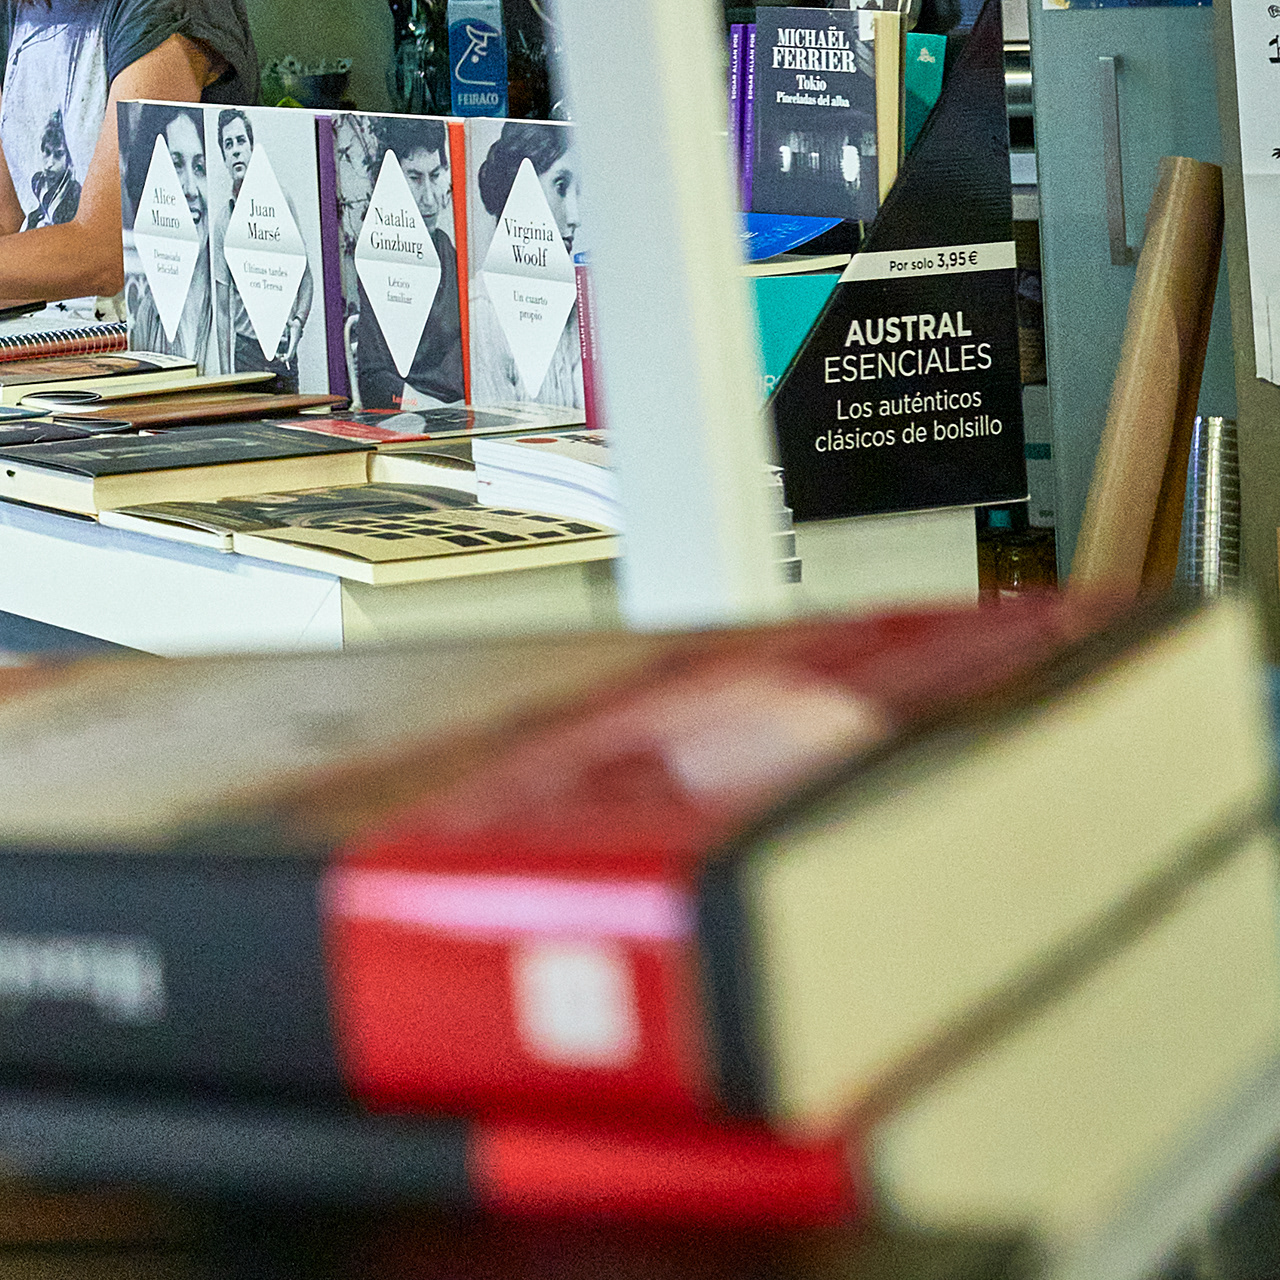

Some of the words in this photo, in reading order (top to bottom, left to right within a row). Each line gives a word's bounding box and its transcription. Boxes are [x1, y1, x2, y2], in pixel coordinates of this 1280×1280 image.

[777, 26, 850, 50] MICHAËL
[771, 46, 856, 73] FERRIER
[795, 74, 827, 92] Tokio
[456, 93, 499, 107] FEIRACO
[776, 91, 816, 106] Pinceladas
[817, 94, 830, 107] del
[830, 95, 850, 108] alba
[152, 189, 176, 206] Alice
[249, 199, 276, 218] Juan
[151, 209, 181, 230] Munro
[374, 208, 416, 230] Natalia
[247, 222, 282, 242] Marsé
[503, 217, 555, 244] Virginia
[370, 231, 424, 260] Ginzburg
[511, 243, 548, 268] Woolf
[243, 263, 268, 277] Últimas
[268, 267, 289, 278] tardes
[889, 260, 908, 272] Por
[911, 258, 934, 271] solo
[249, 280, 261, 289] con
[263, 280, 283, 293] Teresa
[387, 276, 410, 290] Léxico
[386, 291, 413, 305] familiar
[512, 290, 523, 301] Un
[525, 293, 548, 306] cuarto
[576, 274, 585, 326] SHAKESPEARE
[519, 309, 542, 322] propio
[844, 311, 972, 347] AUSTRAL
[824, 343, 992, 383] ESENCIALES
[837, 399, 873, 421] Los
[879, 389, 982, 417] auténticos
[815, 428, 896, 453] clásicos
[902, 422, 928, 445] de
[933, 415, 1003, 442] bolsillo
